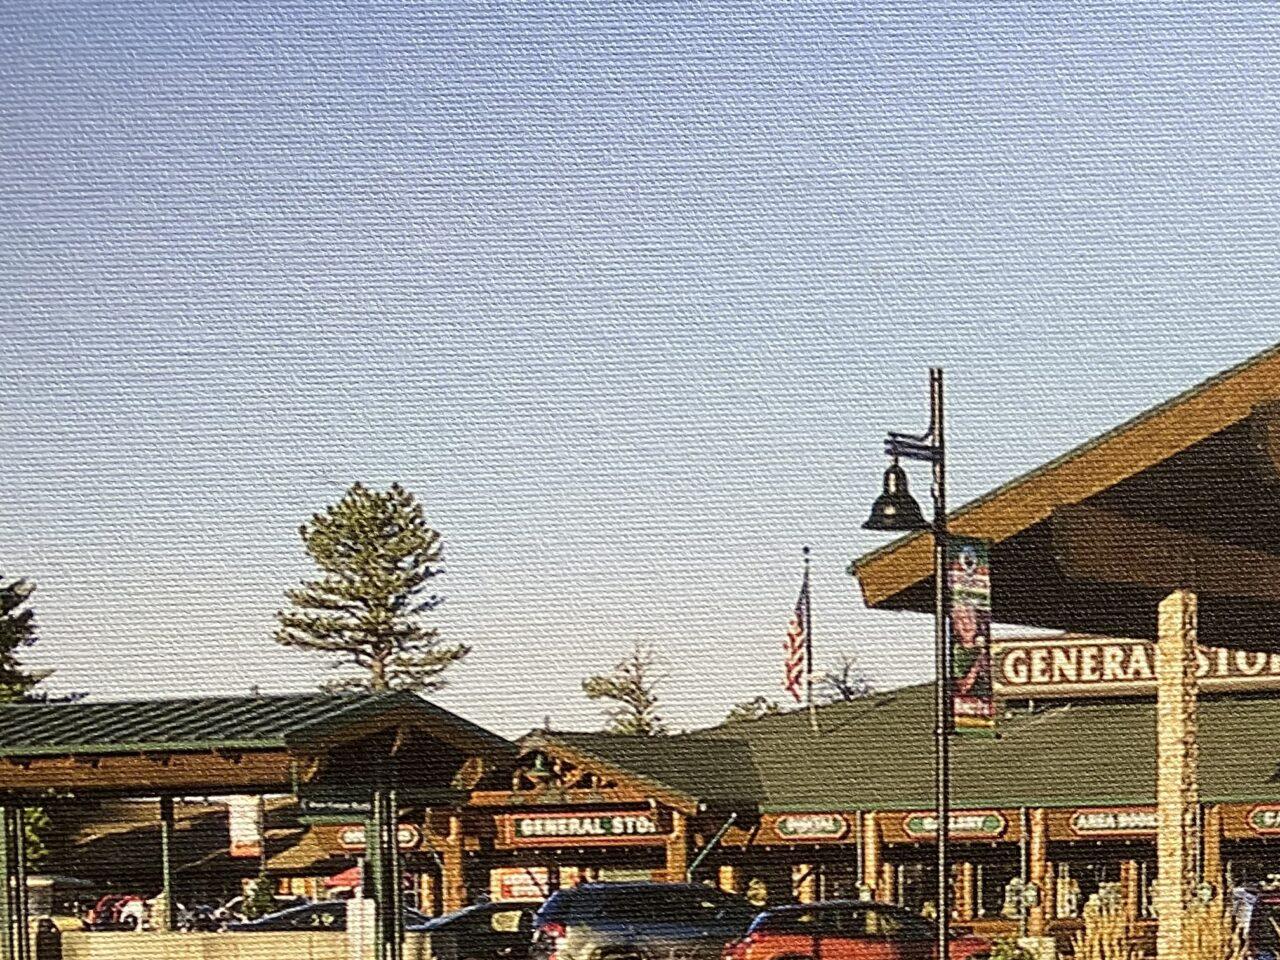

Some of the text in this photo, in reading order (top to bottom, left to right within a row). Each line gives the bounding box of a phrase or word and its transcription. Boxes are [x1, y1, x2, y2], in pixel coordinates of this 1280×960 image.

[1003, 646, 1158, 684] GENERA
[520, 815, 657, 837] GENERAL STO
[1076, 812, 1116, 829] AREA
